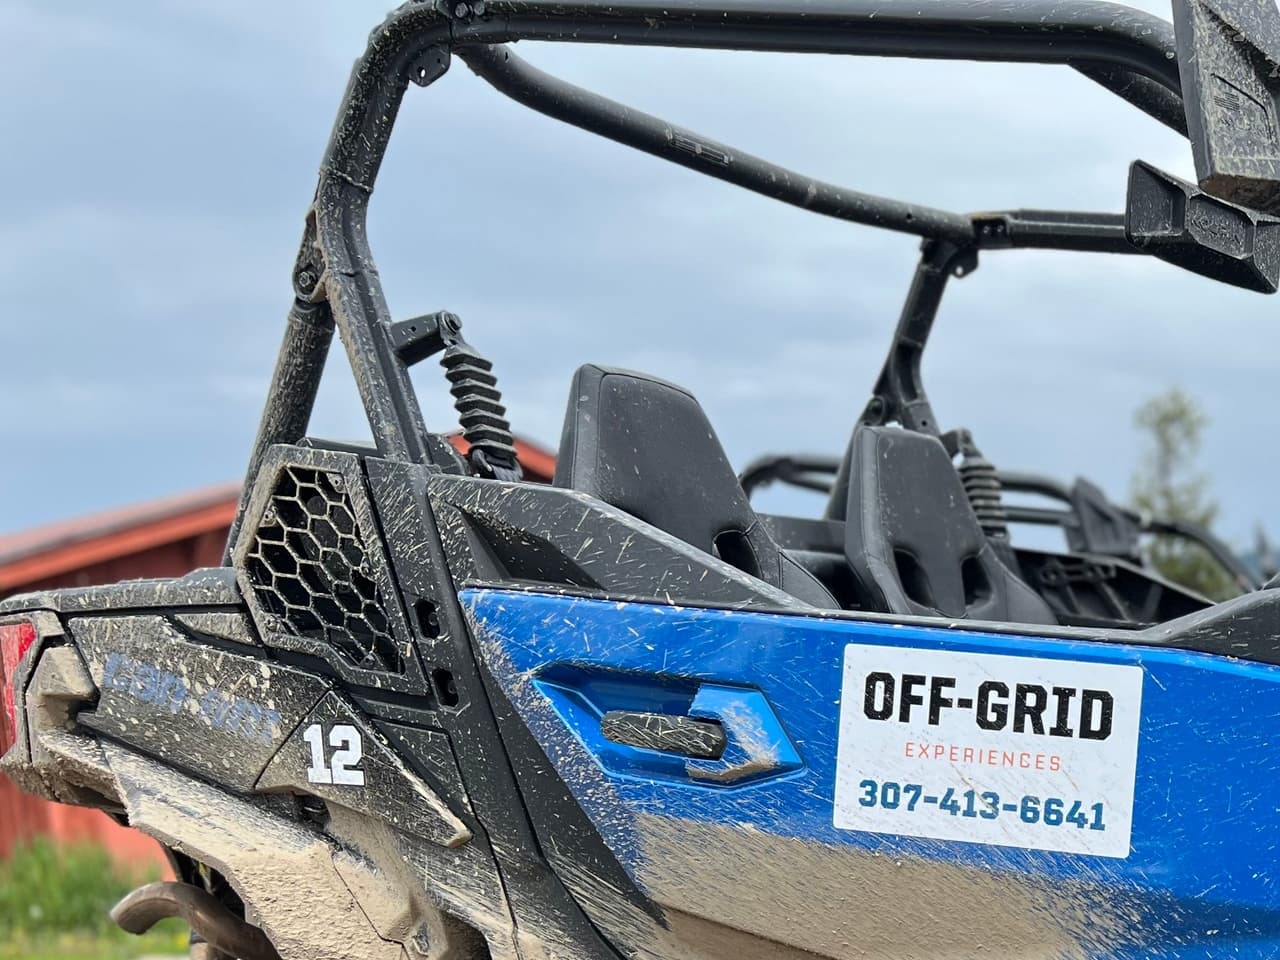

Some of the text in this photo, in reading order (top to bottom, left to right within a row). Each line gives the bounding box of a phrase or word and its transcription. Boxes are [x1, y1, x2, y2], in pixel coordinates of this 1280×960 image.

[863, 671, 1114, 741] OFF-GRID
[303, 723, 366, 786] 12
[905, 742, 1061, 772] EXPERIENCES
[858, 779, 1106, 832] 307-413-6641
